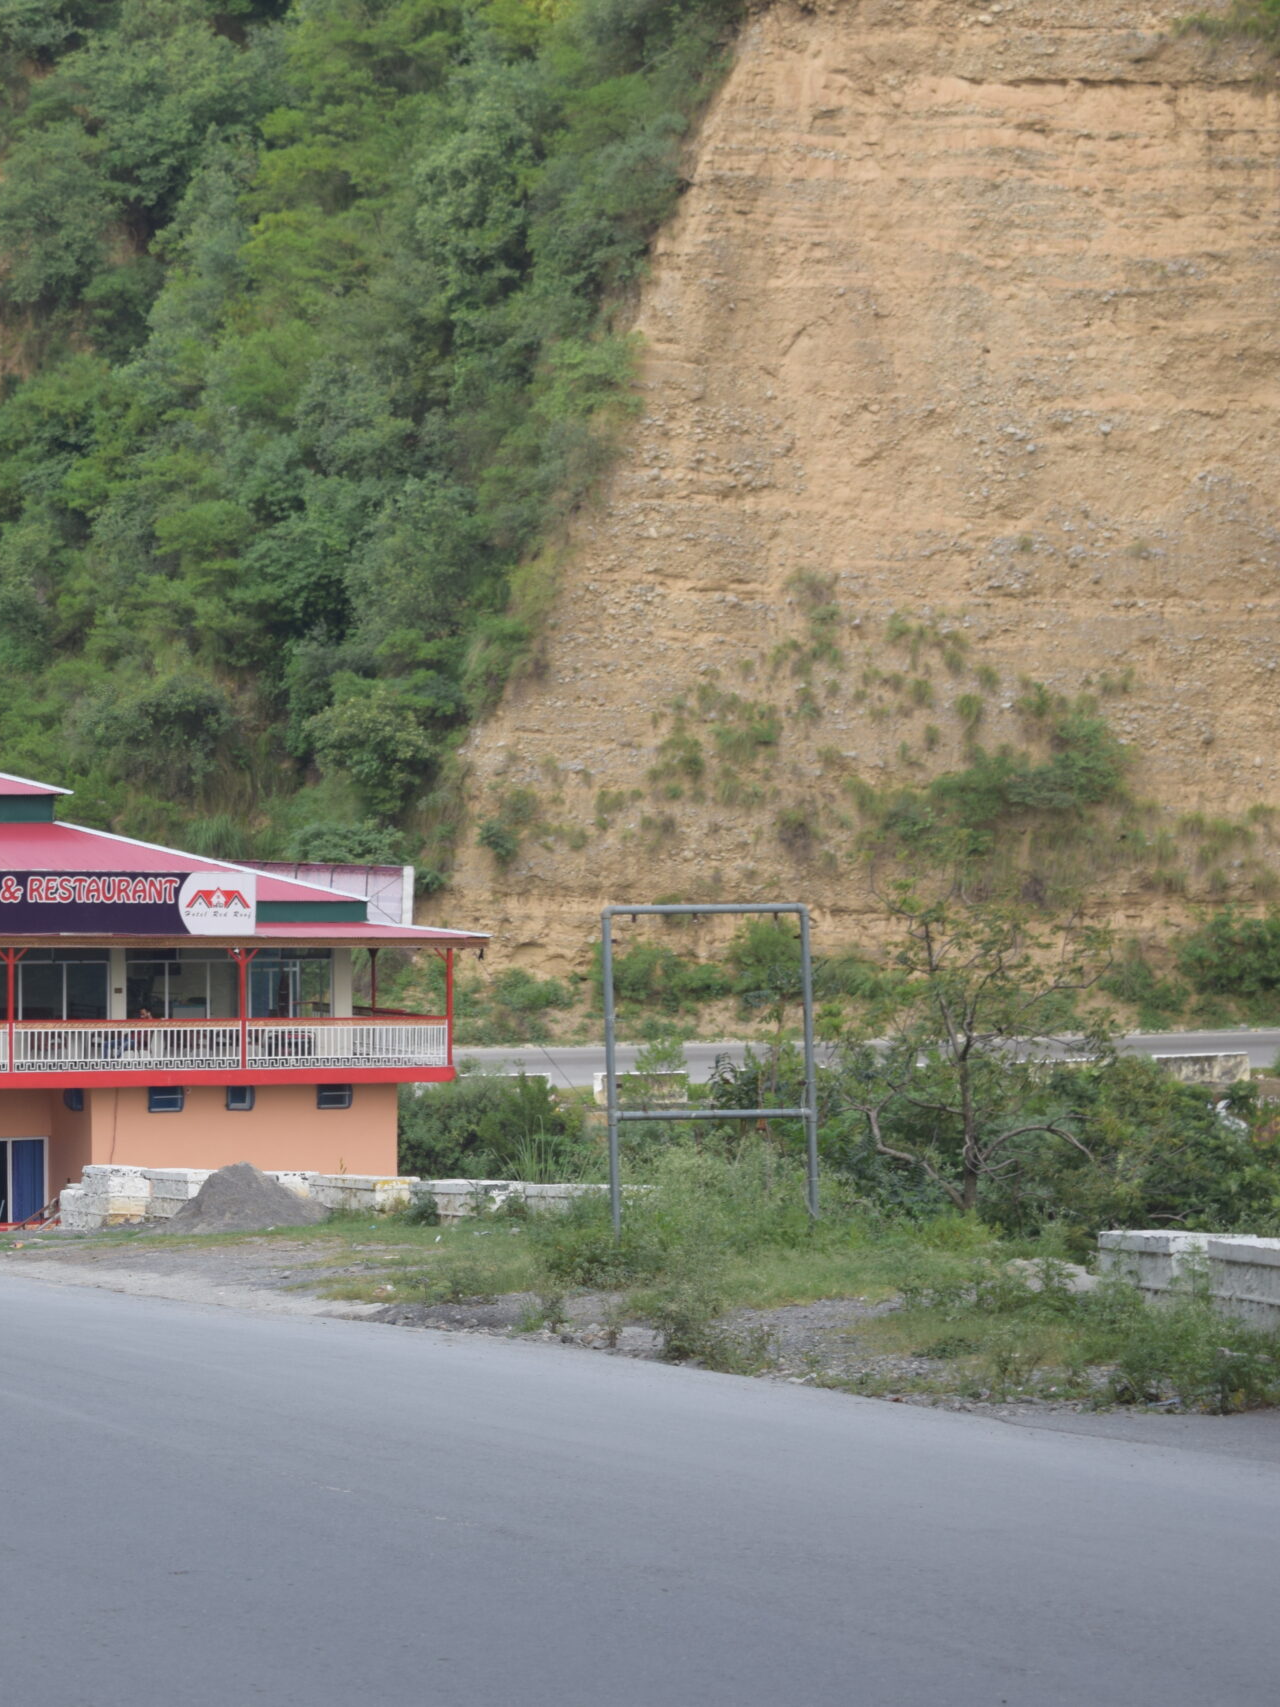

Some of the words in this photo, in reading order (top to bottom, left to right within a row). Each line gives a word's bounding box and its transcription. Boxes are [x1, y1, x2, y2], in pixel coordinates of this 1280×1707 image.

[0, 876, 23, 904] &
[27, 876, 180, 904] RESTAURANT
[184, 910, 208, 918] Hotel
[213, 910, 228, 918] Red
[233, 910, 252, 920] Roof
